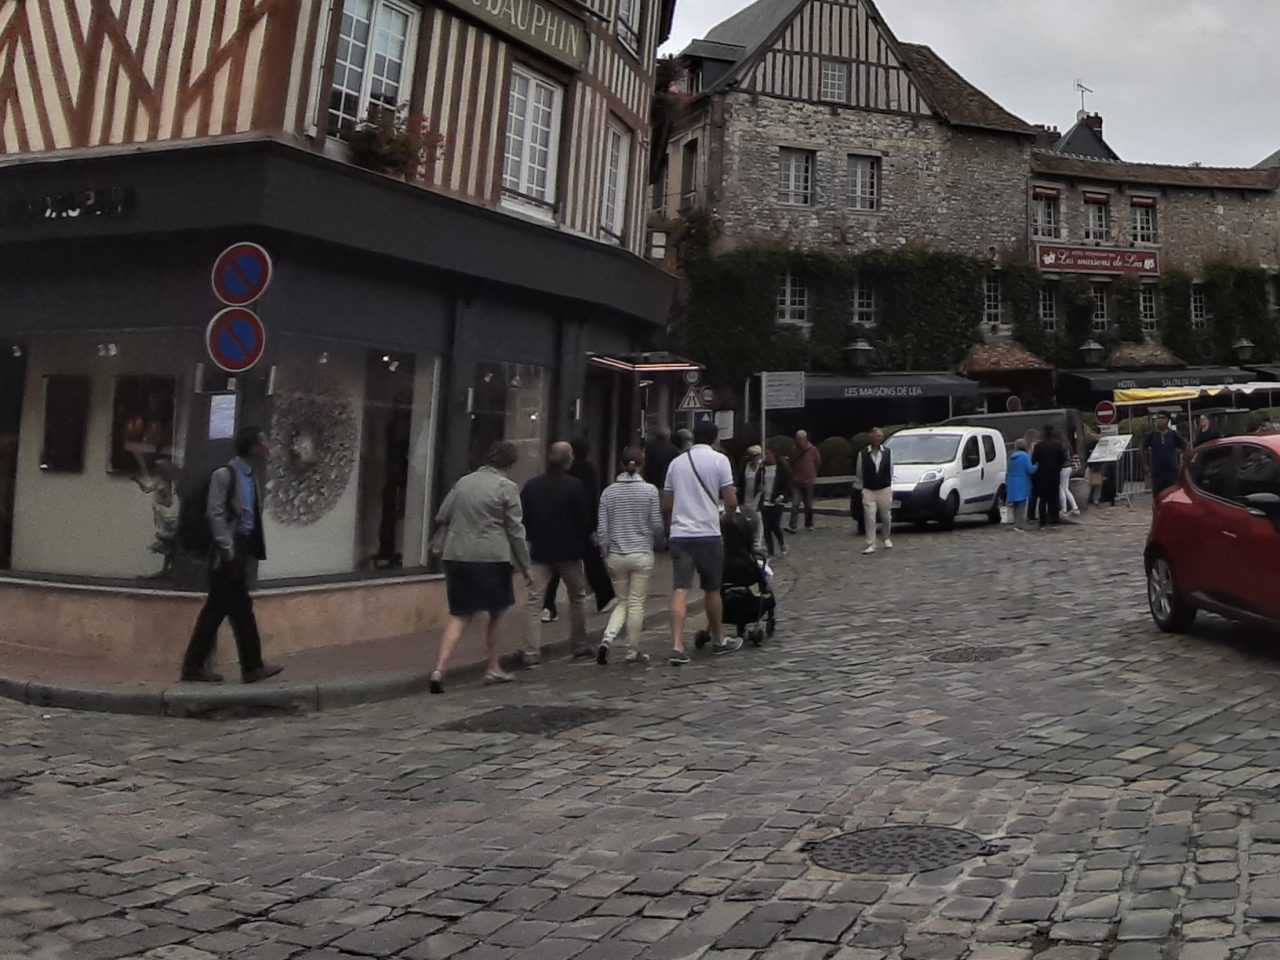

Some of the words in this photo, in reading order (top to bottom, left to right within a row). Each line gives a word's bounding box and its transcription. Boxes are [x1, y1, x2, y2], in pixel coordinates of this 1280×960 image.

[1077, 257, 1110, 267] maisons
[1112, 255, 1122, 267] de
[844, 387, 858, 397] LES
[859, 386, 896, 396] MAISONS
[897, 386, 907, 396] DE
